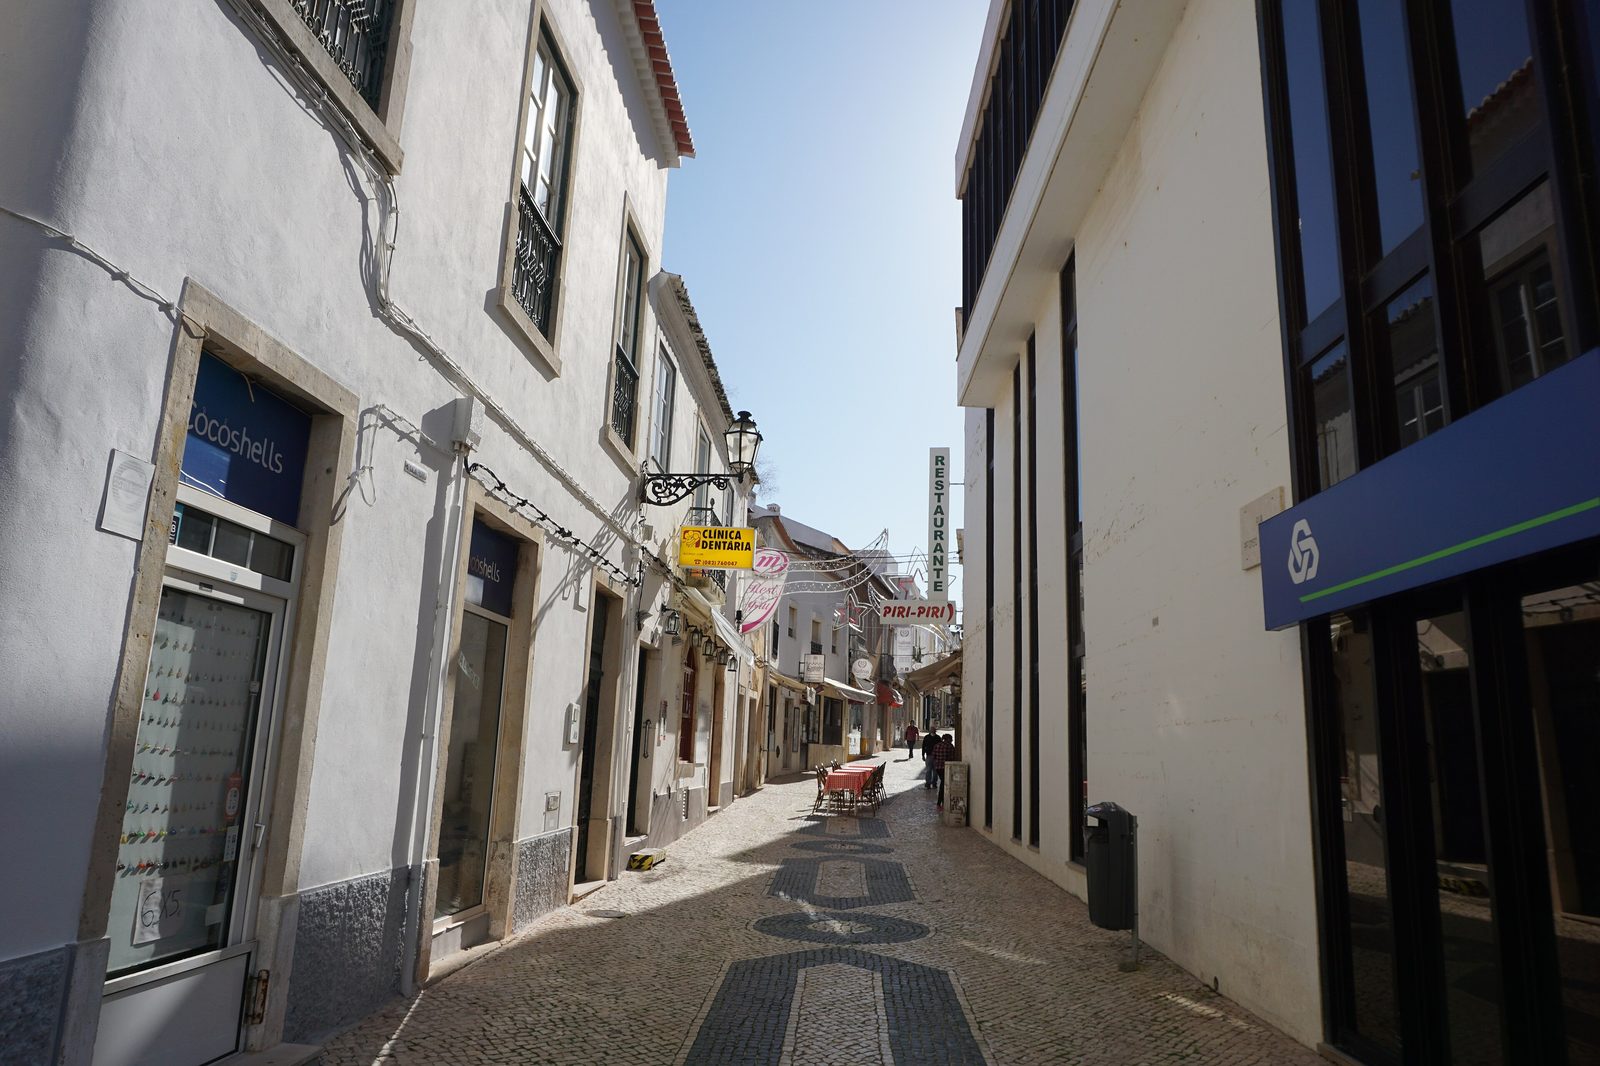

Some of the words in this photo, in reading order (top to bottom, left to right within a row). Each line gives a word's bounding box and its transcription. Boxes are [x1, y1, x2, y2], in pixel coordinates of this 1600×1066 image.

[933, 455, 945, 592] RESTAURANTE
[702, 529, 742, 540] CLÍNICA
[701, 540, 752, 551] DENTÁRIA
[882, 606, 945, 618] PIRI-PIRI
